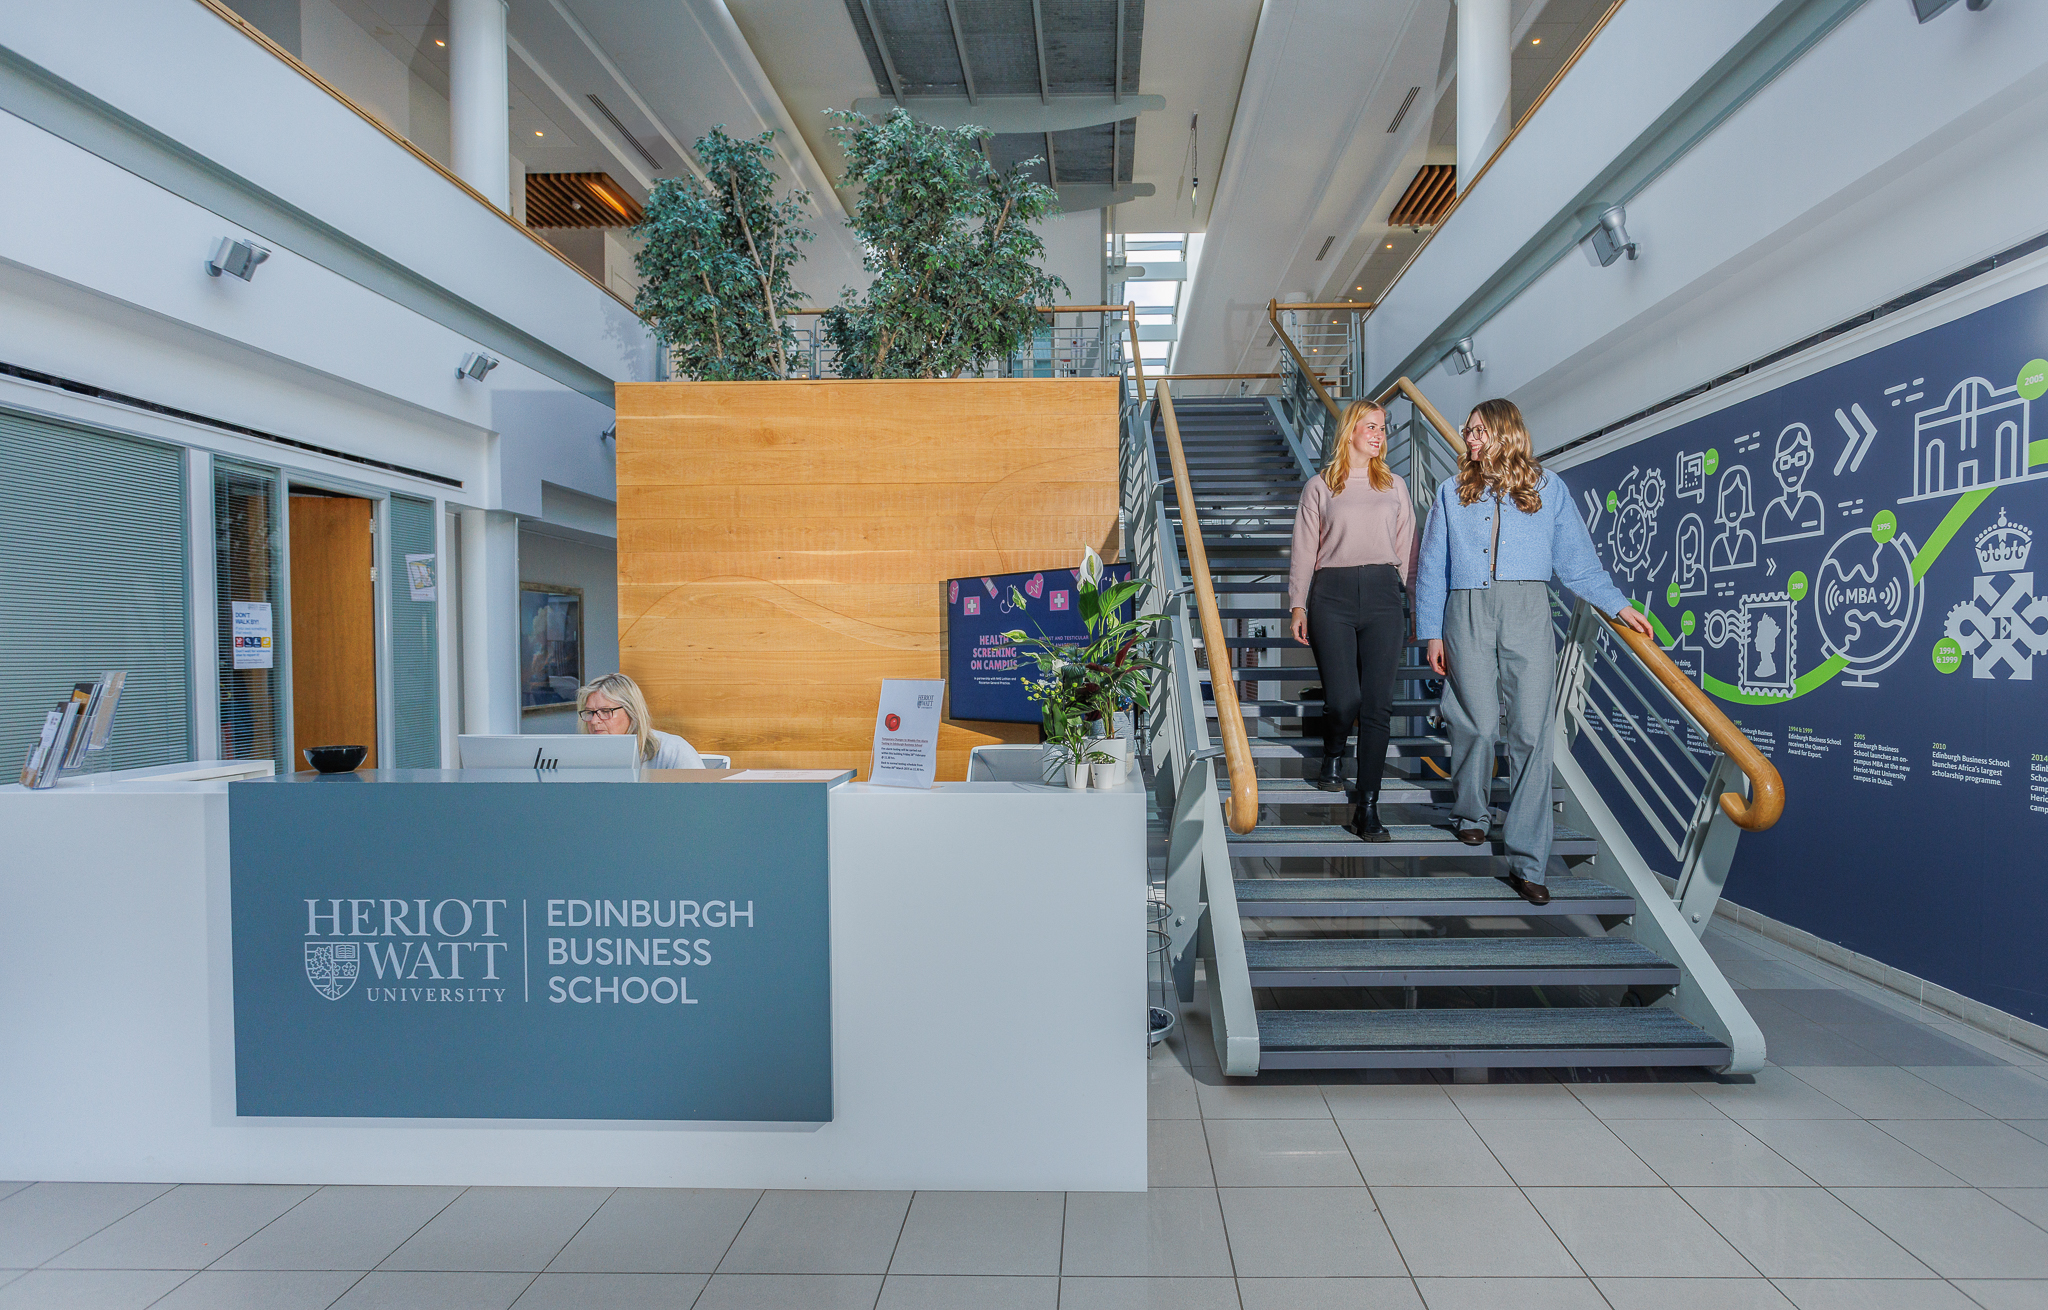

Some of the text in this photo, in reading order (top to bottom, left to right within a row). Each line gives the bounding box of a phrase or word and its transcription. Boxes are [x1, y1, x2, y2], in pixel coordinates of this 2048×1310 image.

[2024, 373, 2044, 386] 2005
[1877, 522, 1891, 531] 1995
[1845, 587, 1877, 604] MBA
[979, 634, 1009, 645] HEALTH
[972, 647, 1017, 658] SCREENING
[970, 660, 1018, 670] ON CAMPUS
[1942, 656, 1958, 664] 1999
[1788, 733, 1808, 742] Edinburgh
[1826, 738, 1842, 746] School
[1932, 742, 1946, 750] 2010
[1853, 741, 1899, 753] Edinburgh Business
[1853, 749, 1869, 758] School
[1869, 751, 1892, 761] launches
[1932, 751, 2010, 768] Edinburgh Business School
[1853, 758, 1871, 766] campus
[1872, 760, 1883, 768] MBA
[1931, 760, 2003, 777] launches Africa's largest
[1853, 766, 1906, 781] Heriot-Watt University
[1931, 769, 2003, 786] scholarship programme.
[2030, 773, 2048, 783] Scho
[1853, 775, 1871, 783] campus
[1877, 778, 1893, 787] Dubai.
[303, 898, 508, 938] HERIOT
[547, 899, 754, 928] EDINBURGH
[548, 937, 712, 966] BUSINESS
[363, 941, 508, 980] WATT
[367, 987, 506, 1002] UNIVERSITY
[548, 976, 698, 1004] SCHOOL
